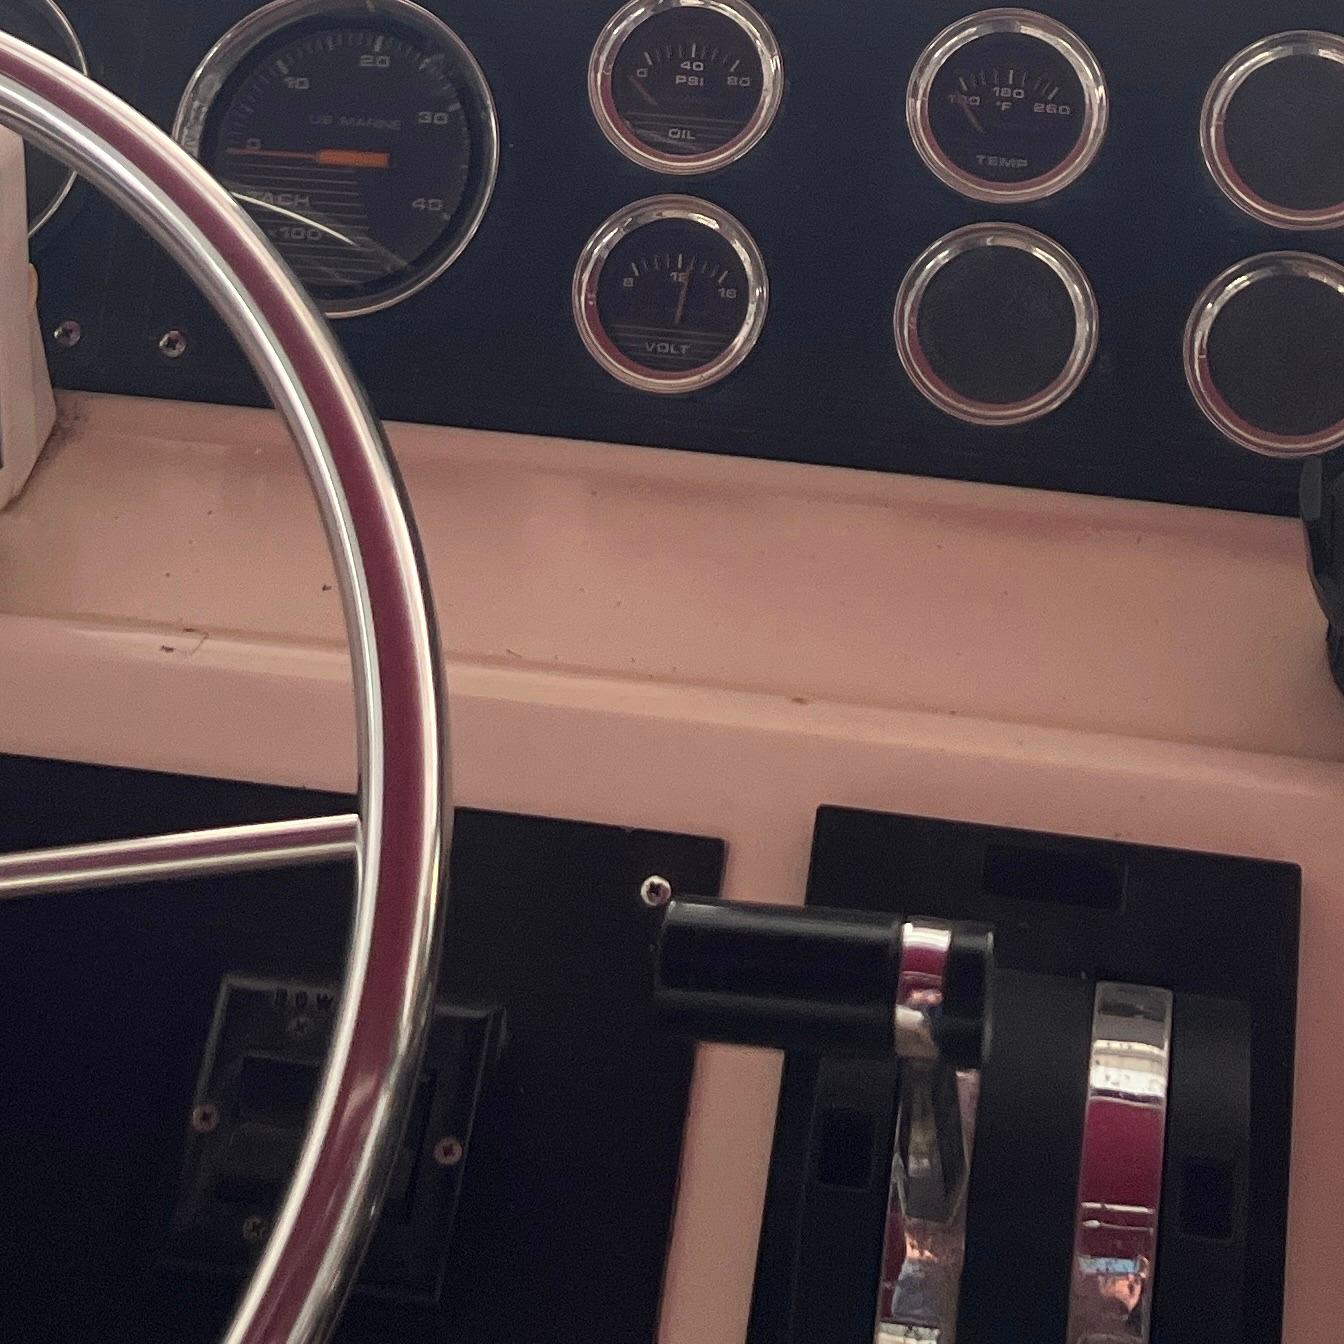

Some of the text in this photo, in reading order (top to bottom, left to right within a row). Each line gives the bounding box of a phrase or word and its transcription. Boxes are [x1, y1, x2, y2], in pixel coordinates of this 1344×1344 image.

[359, 55, 391, 68] 20
[680, 60, 704, 72] 40
[284, 77, 309, 90] 10
[675, 75, 704, 87] PSI
[727, 76, 751, 88] 80
[992, 86, 1025, 99] 180
[1033, 103, 1071, 116] 260
[340, 115, 402, 131] MARINE
[418, 111, 448, 124] 30
[668, 128, 695, 140] OIL
[975, 155, 1028, 168] TEMP
[412, 198, 443, 211] 40
[623, 277, 737, 299] 8 16
[644, 341, 691, 354] VOLT
